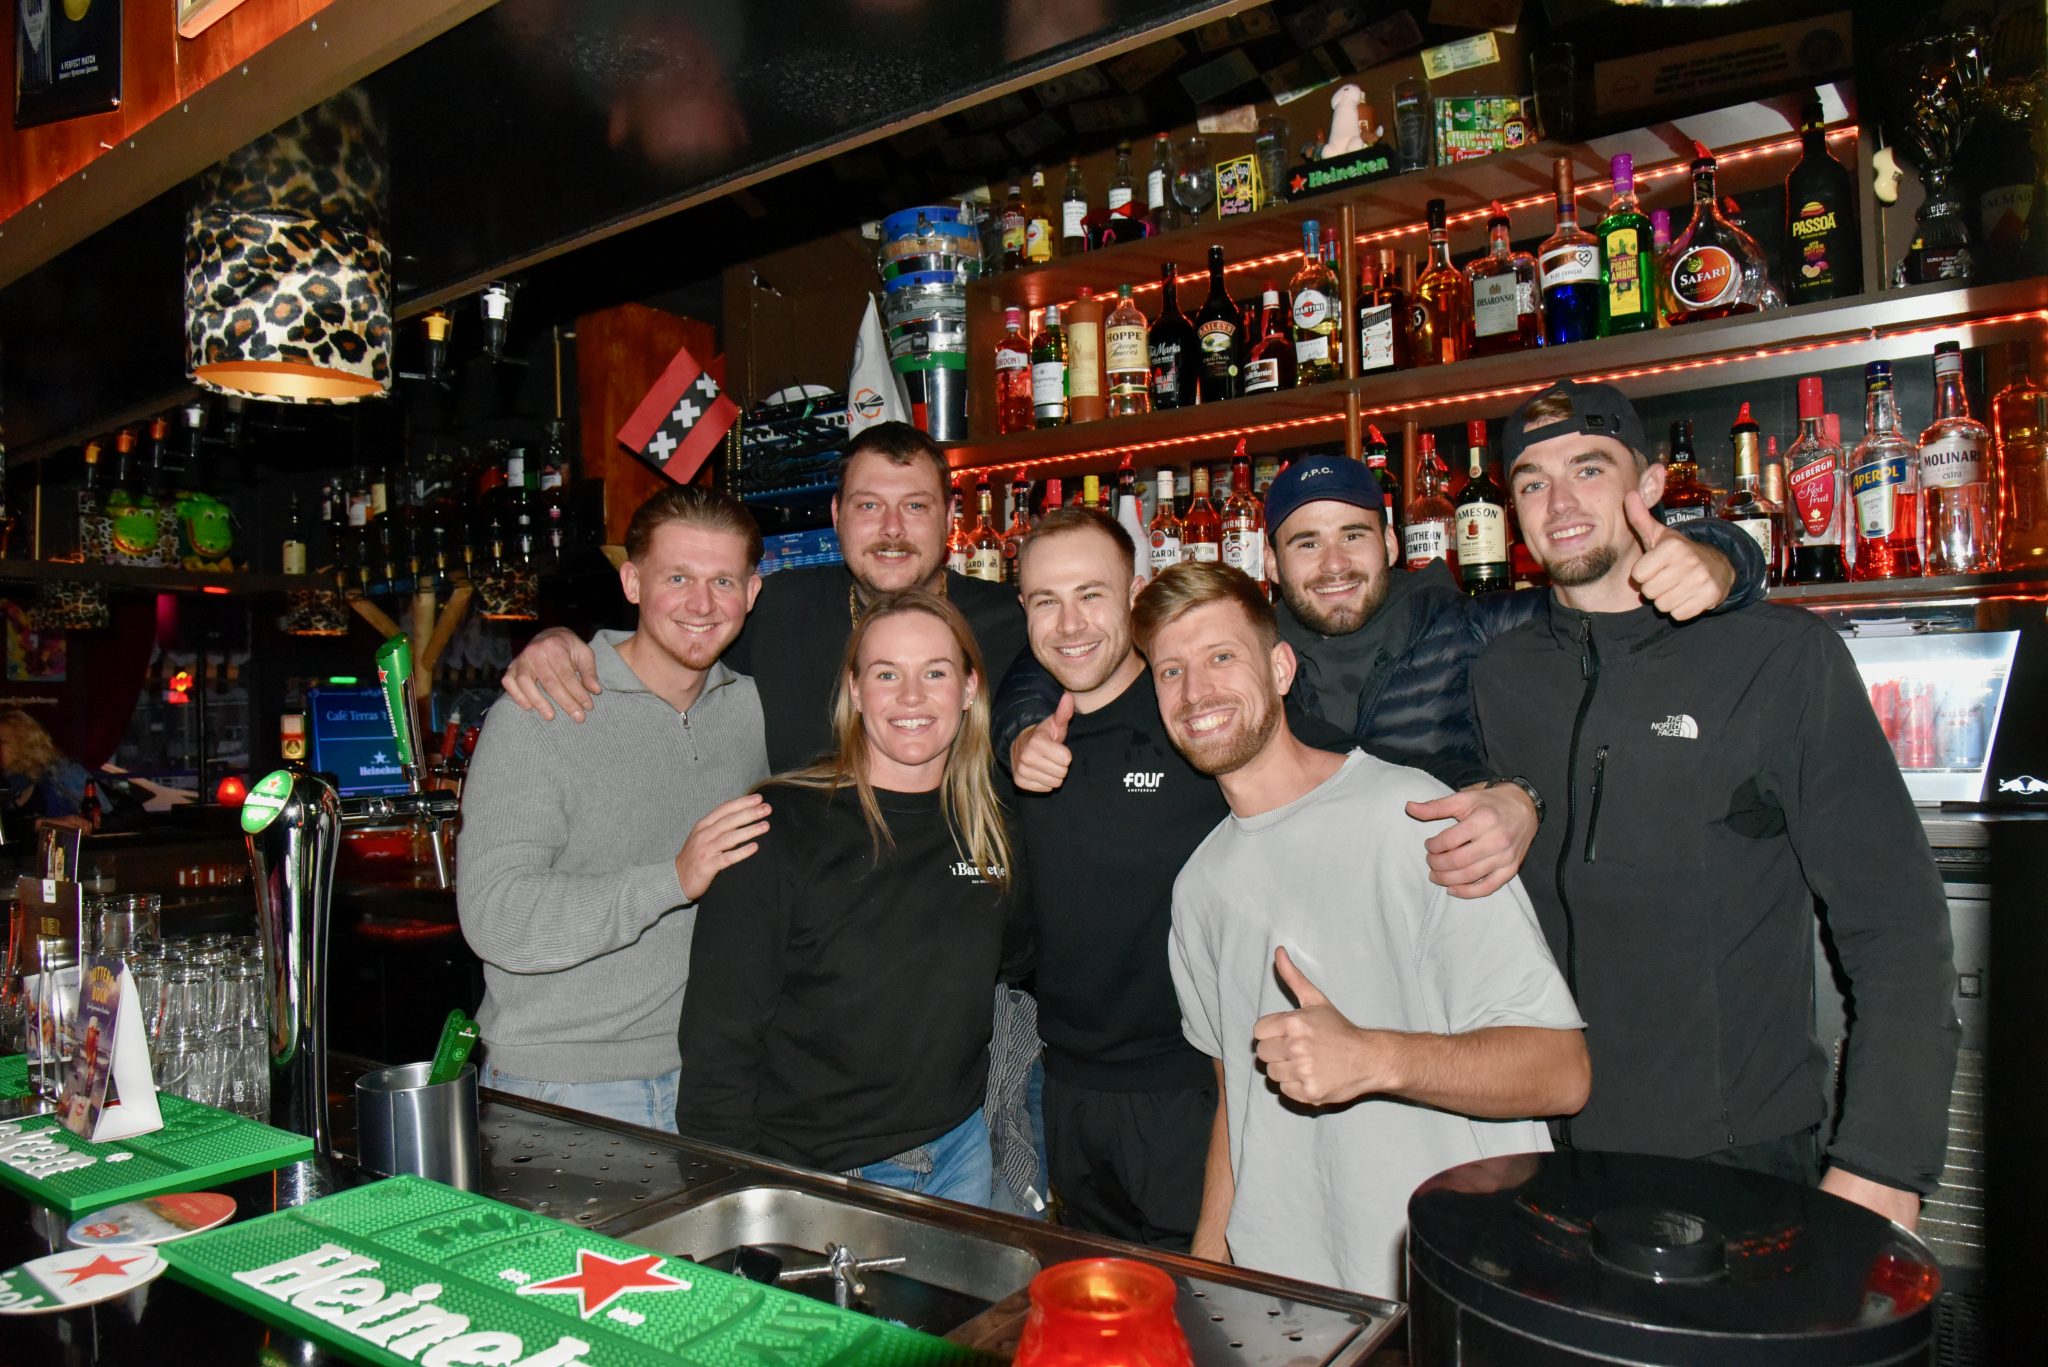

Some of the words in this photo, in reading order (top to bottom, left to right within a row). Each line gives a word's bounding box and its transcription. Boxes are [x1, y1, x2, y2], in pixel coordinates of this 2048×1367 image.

[64, 57, 81, 70] PERFECT
[81, 54, 96, 66] MATCH
[1453, 131, 1499, 139] Heineken
[1447, 138, 1503, 147] Millenniu
[1308, 156, 1389, 188] Heineken
[1611, 259, 1637, 272] PISANG
[1611, 268, 1637, 282] AMBON
[1680, 266, 1726, 286] SAFARI
[1107, 331, 1142, 342] HOPPE
[1790, 459, 1833, 486] COEBERGH
[1853, 465, 1900, 492] APEROL
[1798, 481, 1824, 499] Red
[1808, 493, 1829, 508] fruit
[326, 710, 348, 720] Café
[349, 710, 378, 720] Terras
[1666, 714, 1683, 723] THE
[1650, 721, 1681, 731] NORTH
[1656, 728, 1681, 737] FACE
[1123, 772, 1165, 788] four
[231, 1242, 590, 1367] Heine
